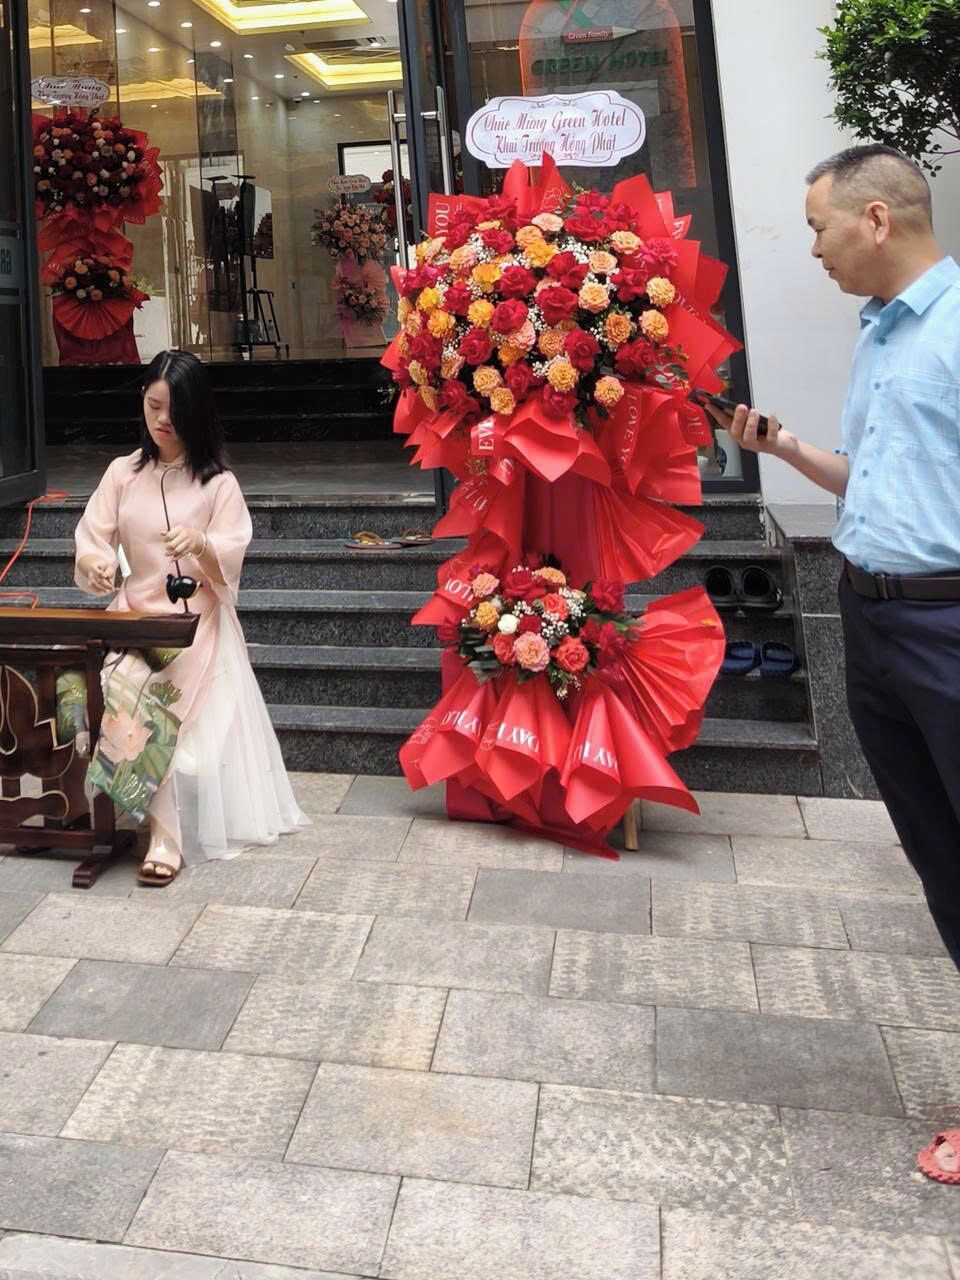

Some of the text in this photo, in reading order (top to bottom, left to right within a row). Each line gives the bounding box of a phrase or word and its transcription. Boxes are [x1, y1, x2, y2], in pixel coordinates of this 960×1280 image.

[551, 110, 585, 133] Green
[592, 108, 626, 128] Hotel
[495, 134, 518, 154] Khai
[435, 201, 450, 235] YOU
